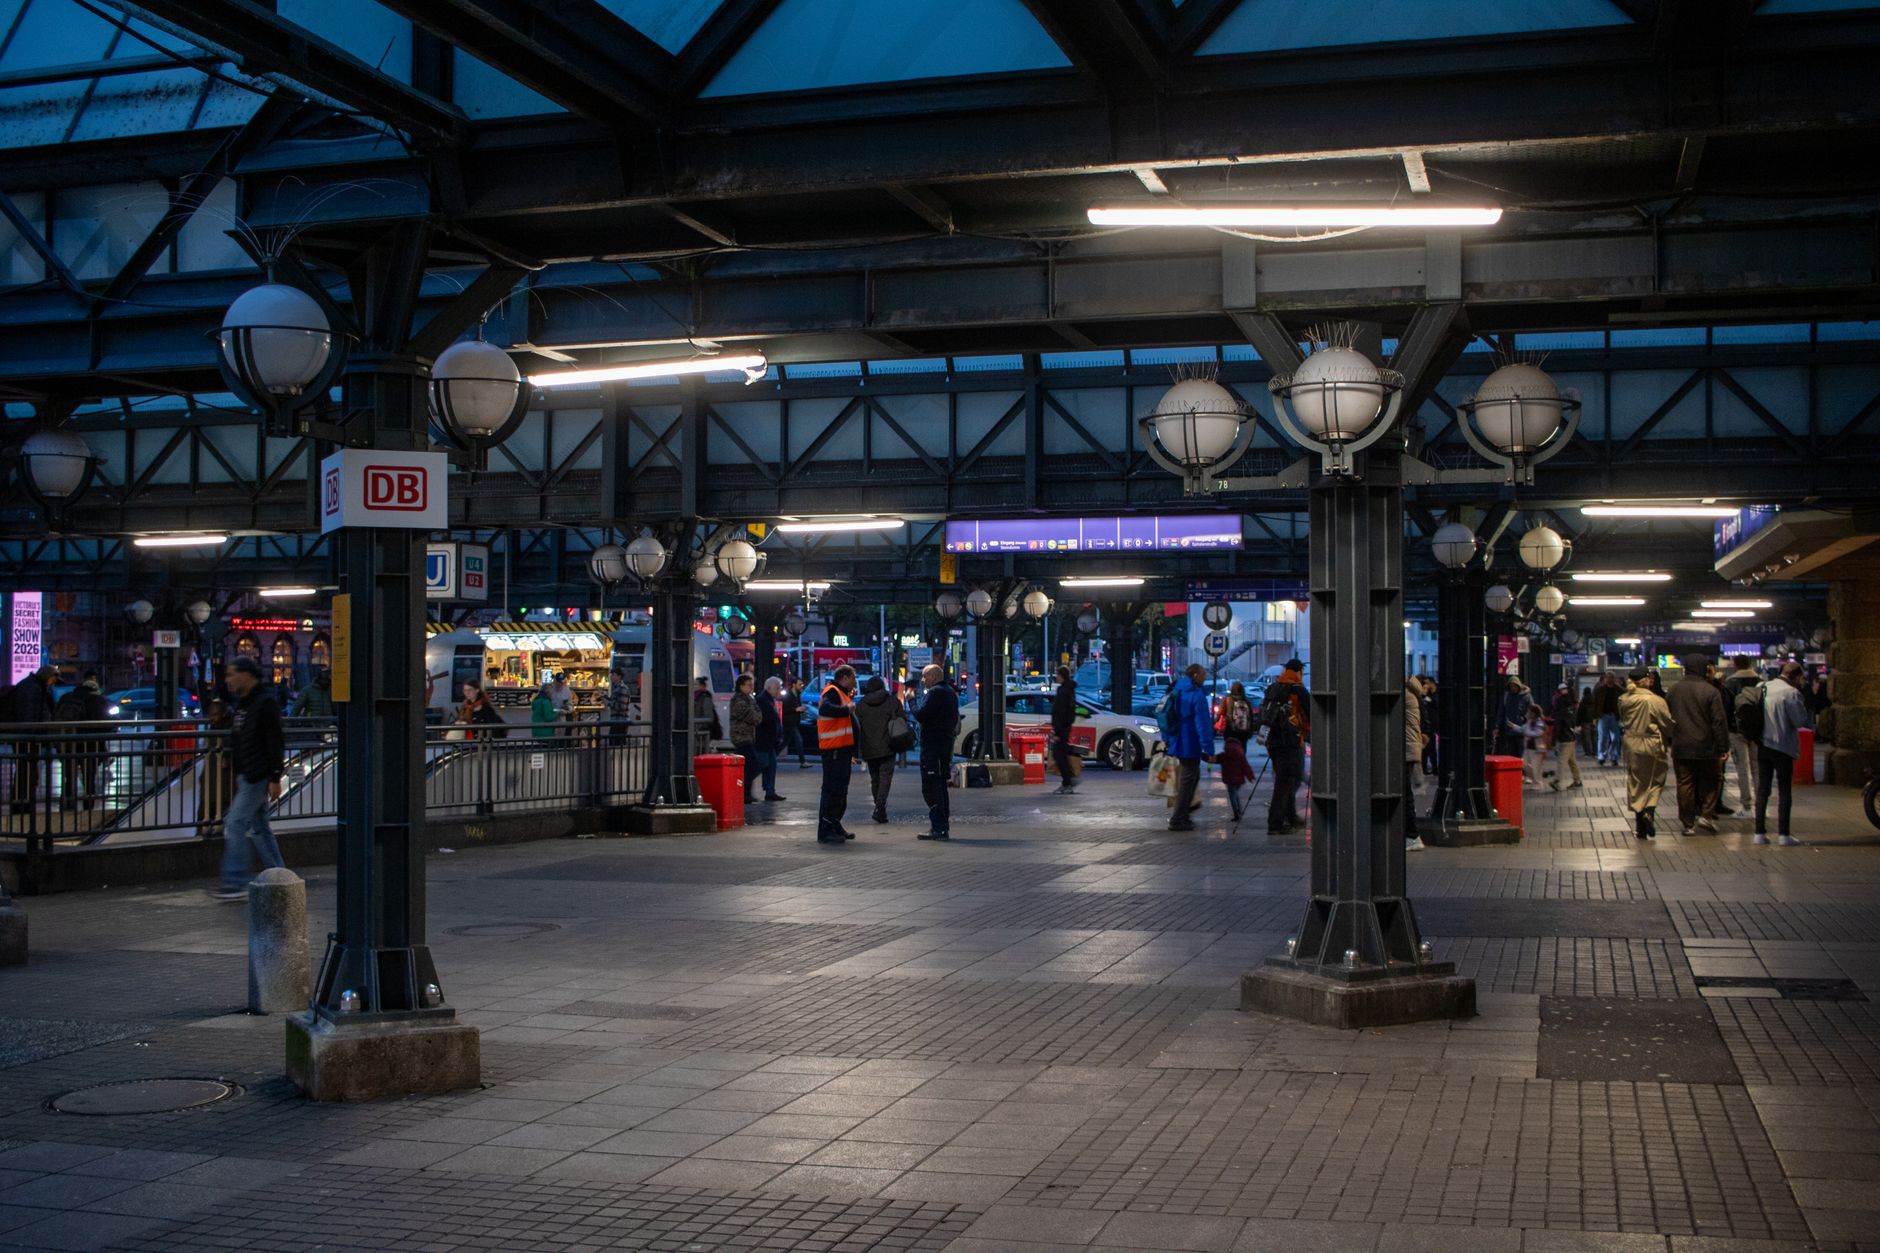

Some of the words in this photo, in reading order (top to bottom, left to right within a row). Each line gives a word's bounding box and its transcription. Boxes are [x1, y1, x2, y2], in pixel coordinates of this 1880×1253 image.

[371, 473, 420, 504] DB
[1218, 480, 1228, 490] 78
[326, 477, 338, 507] DB
[469, 559, 480, 570] U4
[427, 556, 443, 586] U
[469, 575, 480, 586] U2
[15, 601, 41, 609] VICTORIA'S
[14, 618, 40, 628] FASHION
[14, 629, 40, 642] SHOW
[833, 635, 850, 647] OTEL
[14, 643, 39, 655] 2026
[1590, 639, 1605, 654] S
